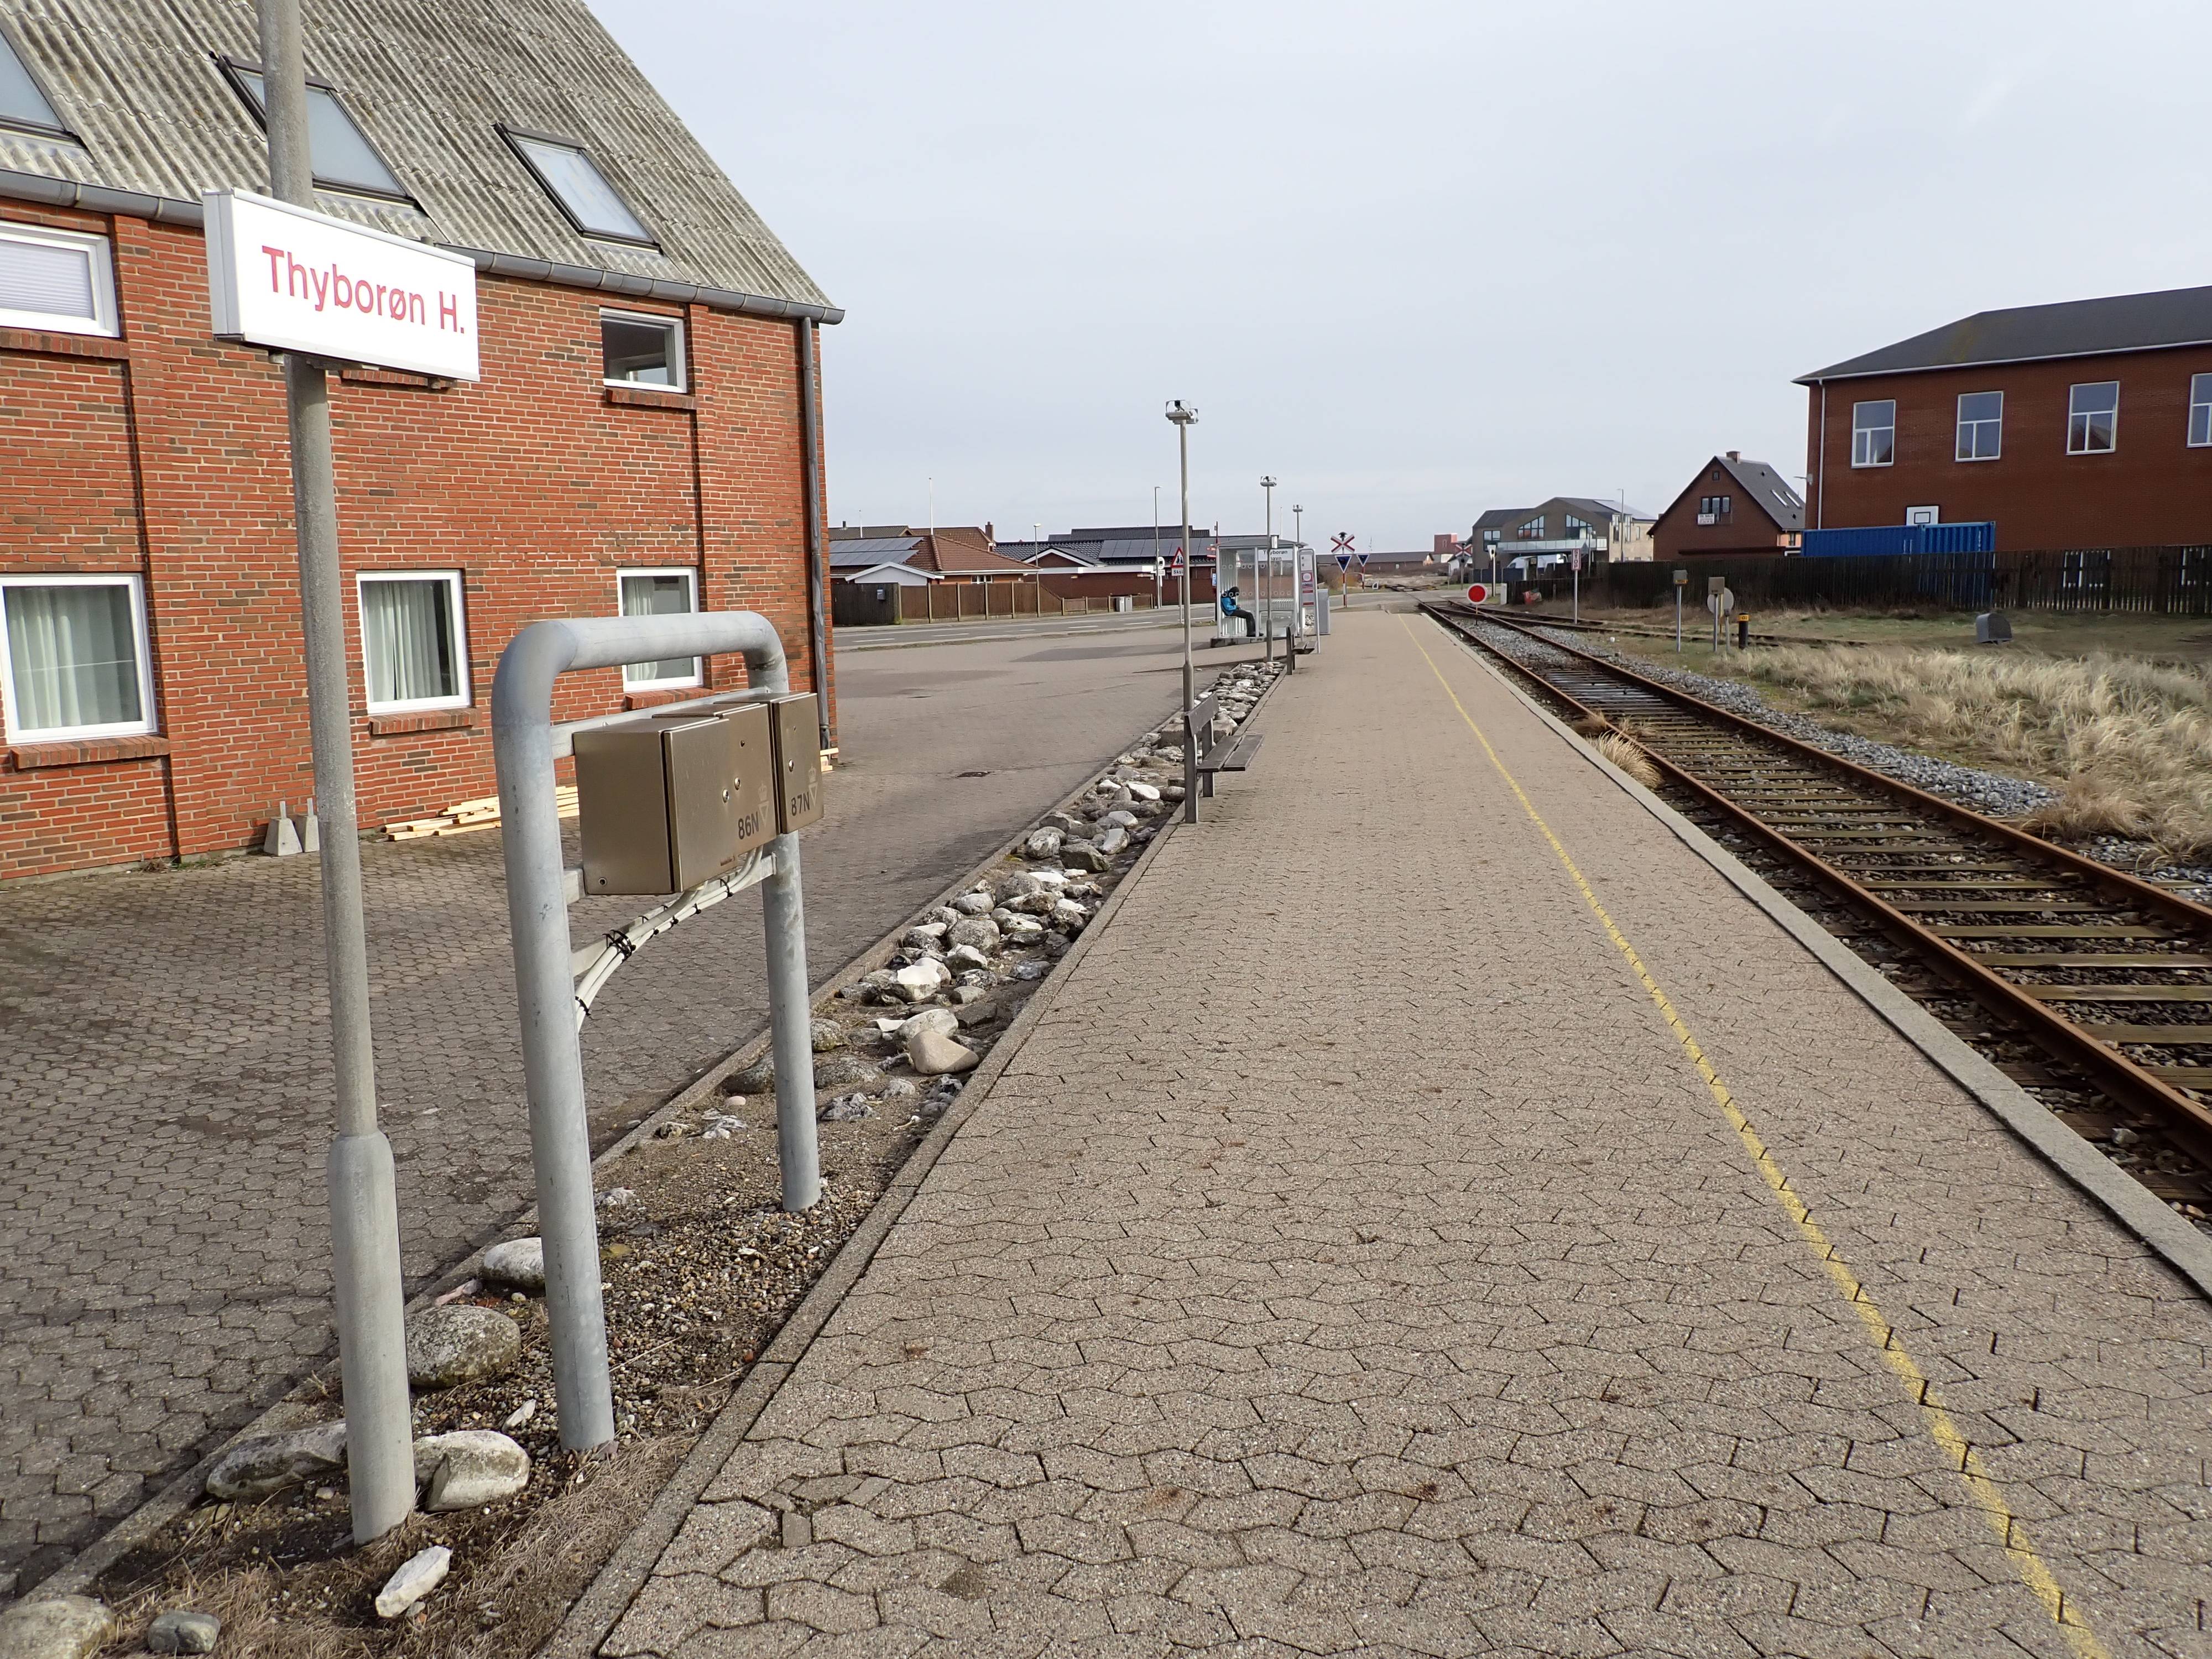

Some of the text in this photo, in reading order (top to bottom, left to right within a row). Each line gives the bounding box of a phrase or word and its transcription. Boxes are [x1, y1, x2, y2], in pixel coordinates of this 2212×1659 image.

[262, 245, 465, 334] Thyborøn H.
[791, 791, 810, 816] 87N
[738, 811, 759, 839] 86N
